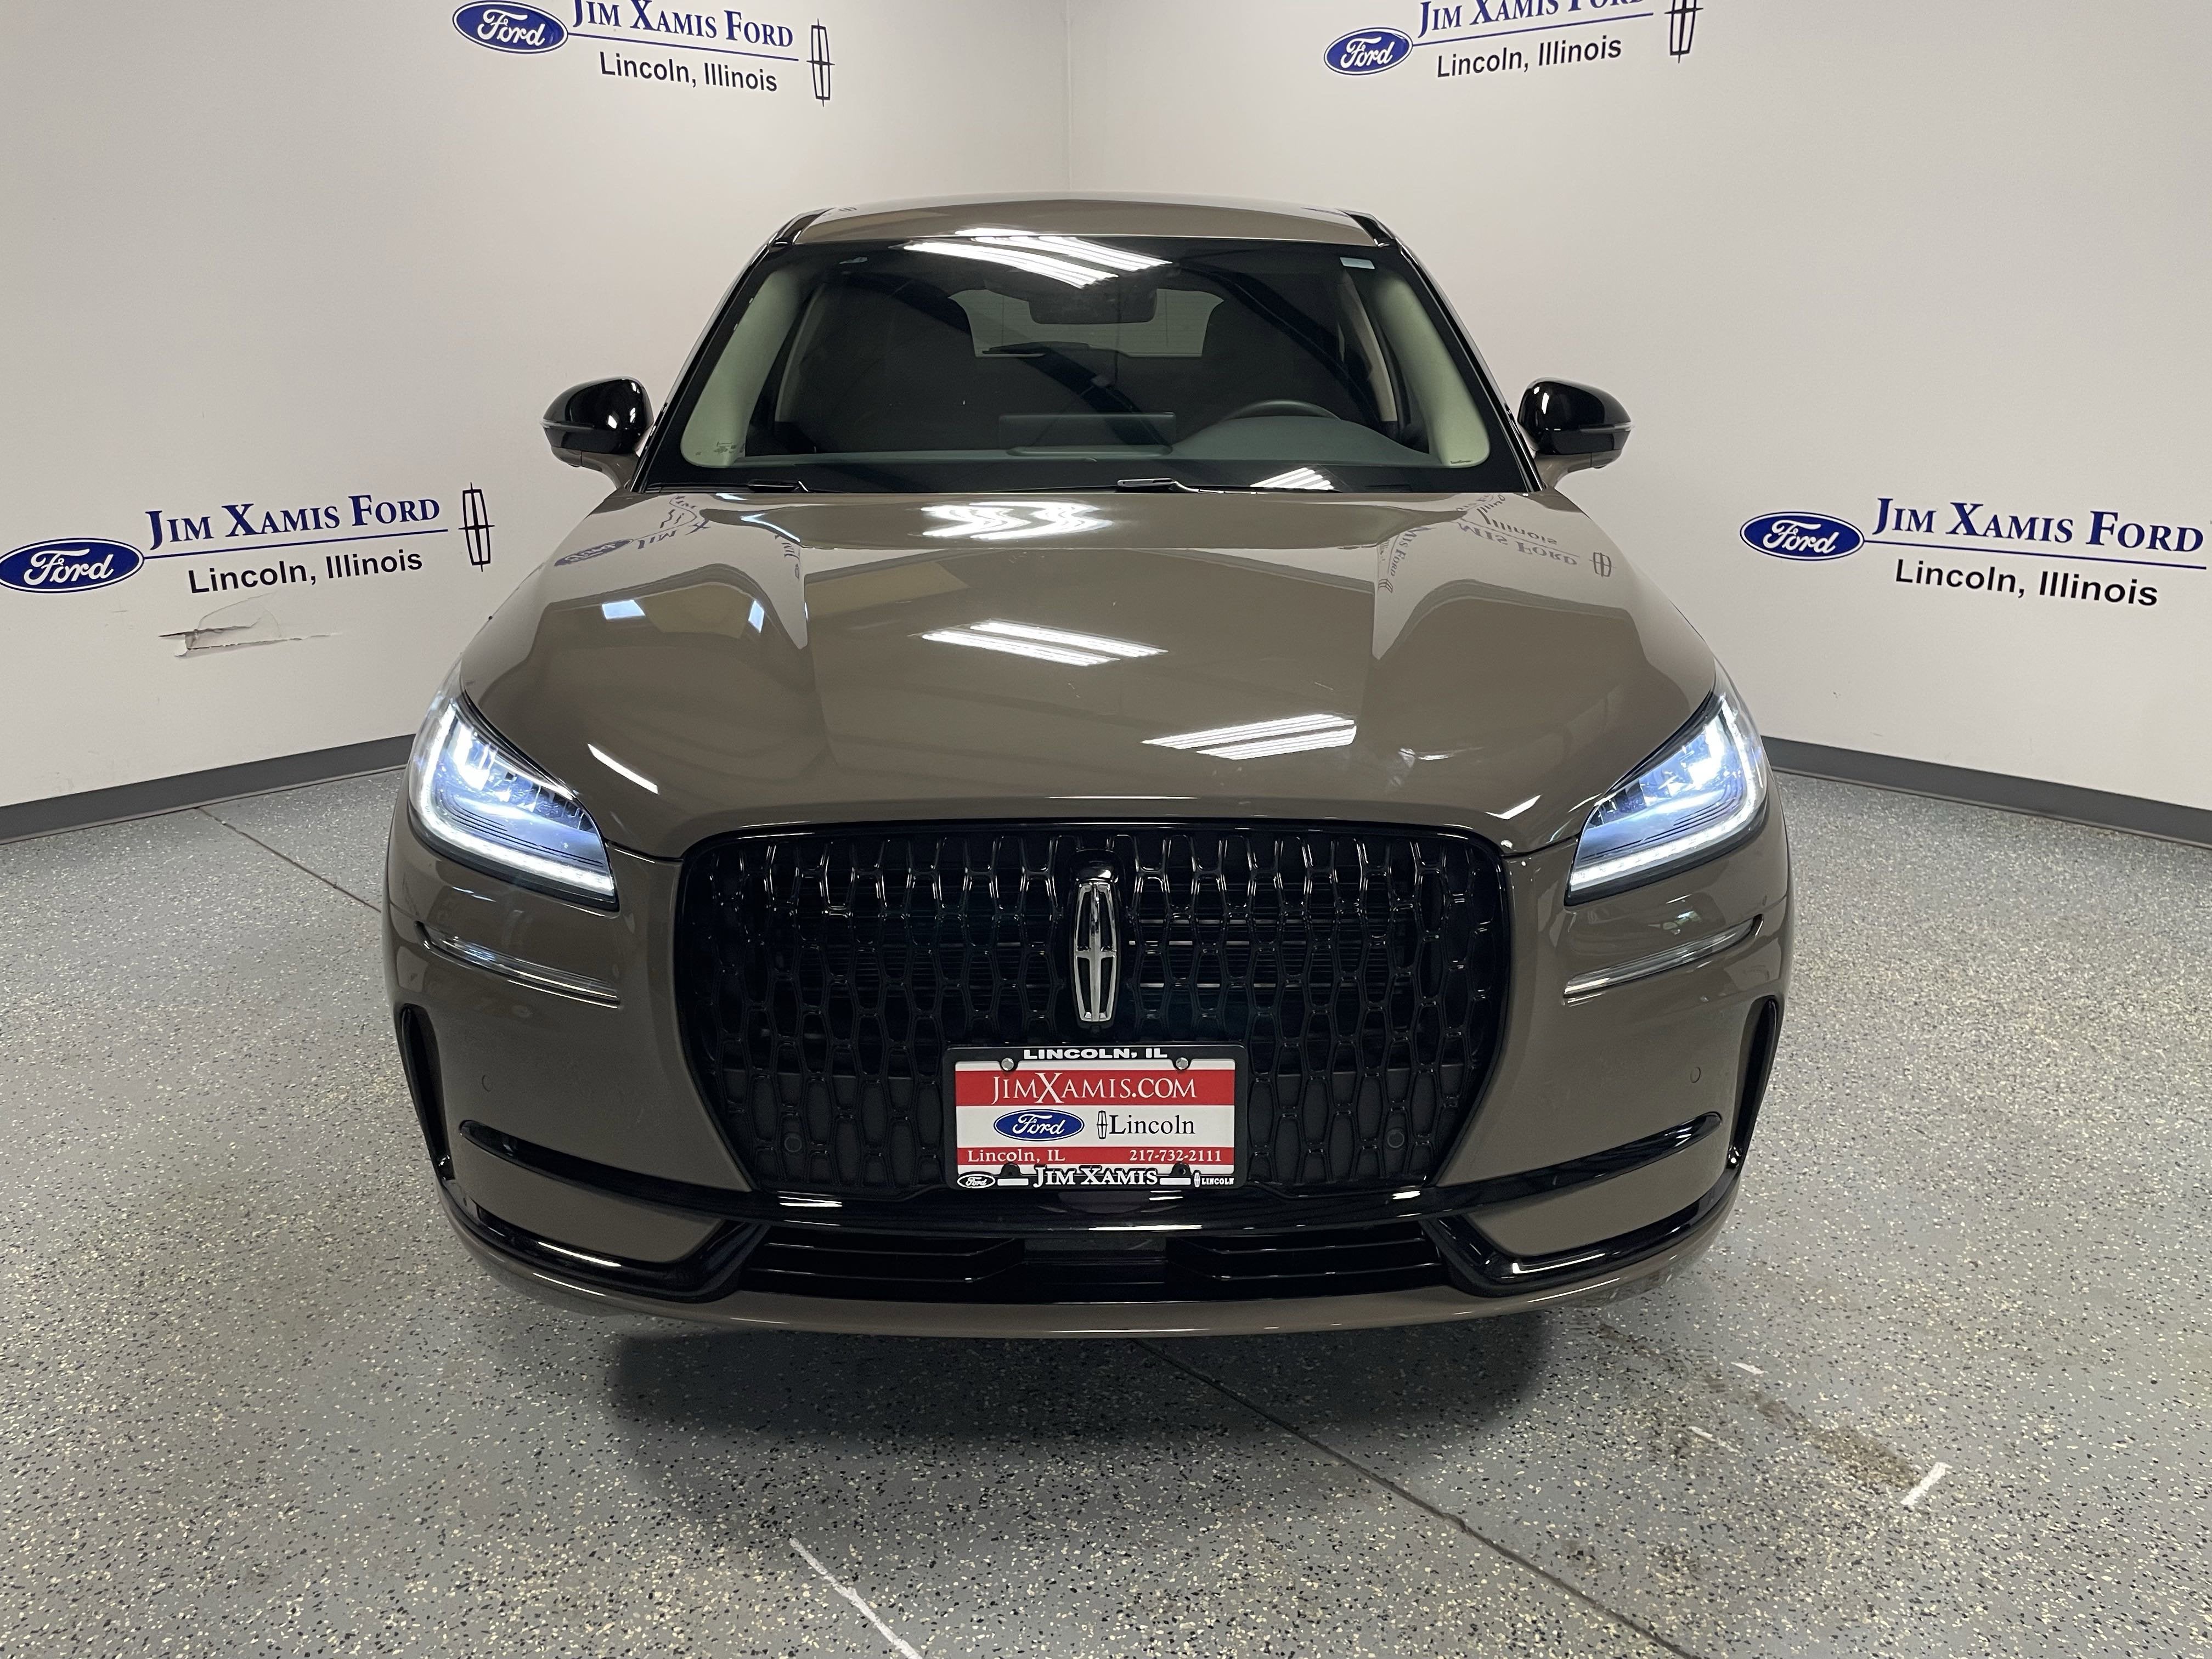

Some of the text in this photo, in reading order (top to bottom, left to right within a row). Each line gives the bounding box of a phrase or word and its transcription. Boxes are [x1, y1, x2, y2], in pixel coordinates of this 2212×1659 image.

[476, 9, 545, 47] Ford
[573, 0, 792, 47] JIM XAMIS FORD
[1418, 0, 1558, 38] JIM XAMIS
[1340, 36, 1394, 69] Ford
[1438, 35, 1621, 77] Lincoln, Illinois
[600, 52, 776, 91] Lincoln, Illinois
[145, 494, 441, 550] JIM XAMIS FORD
[1762, 520, 1836, 554] Ford
[1872, 498, 2203, 551] JIM XAMIS FORD
[23, 549, 114, 582] Ford
[189, 549, 422, 593] Lincoln, Illinois
[1896, 559, 2157, 606] Lincoln, Illinois
[1024, 1048, 1168, 1059] LINCOLN, IL
[1012, 1113, 1065, 1135] Ford
[1109, 1115, 1195, 1134] Lincoln
[968, 1149, 1065, 1164] Lincoln, IL
[1130, 1150, 1221, 1161] 217-732-2111
[965, 1176, 987, 1187] Ford
[1033, 1167, 1158, 1188] JIM XAMIS
[1201, 1177, 1234, 1186] LINCOLN
